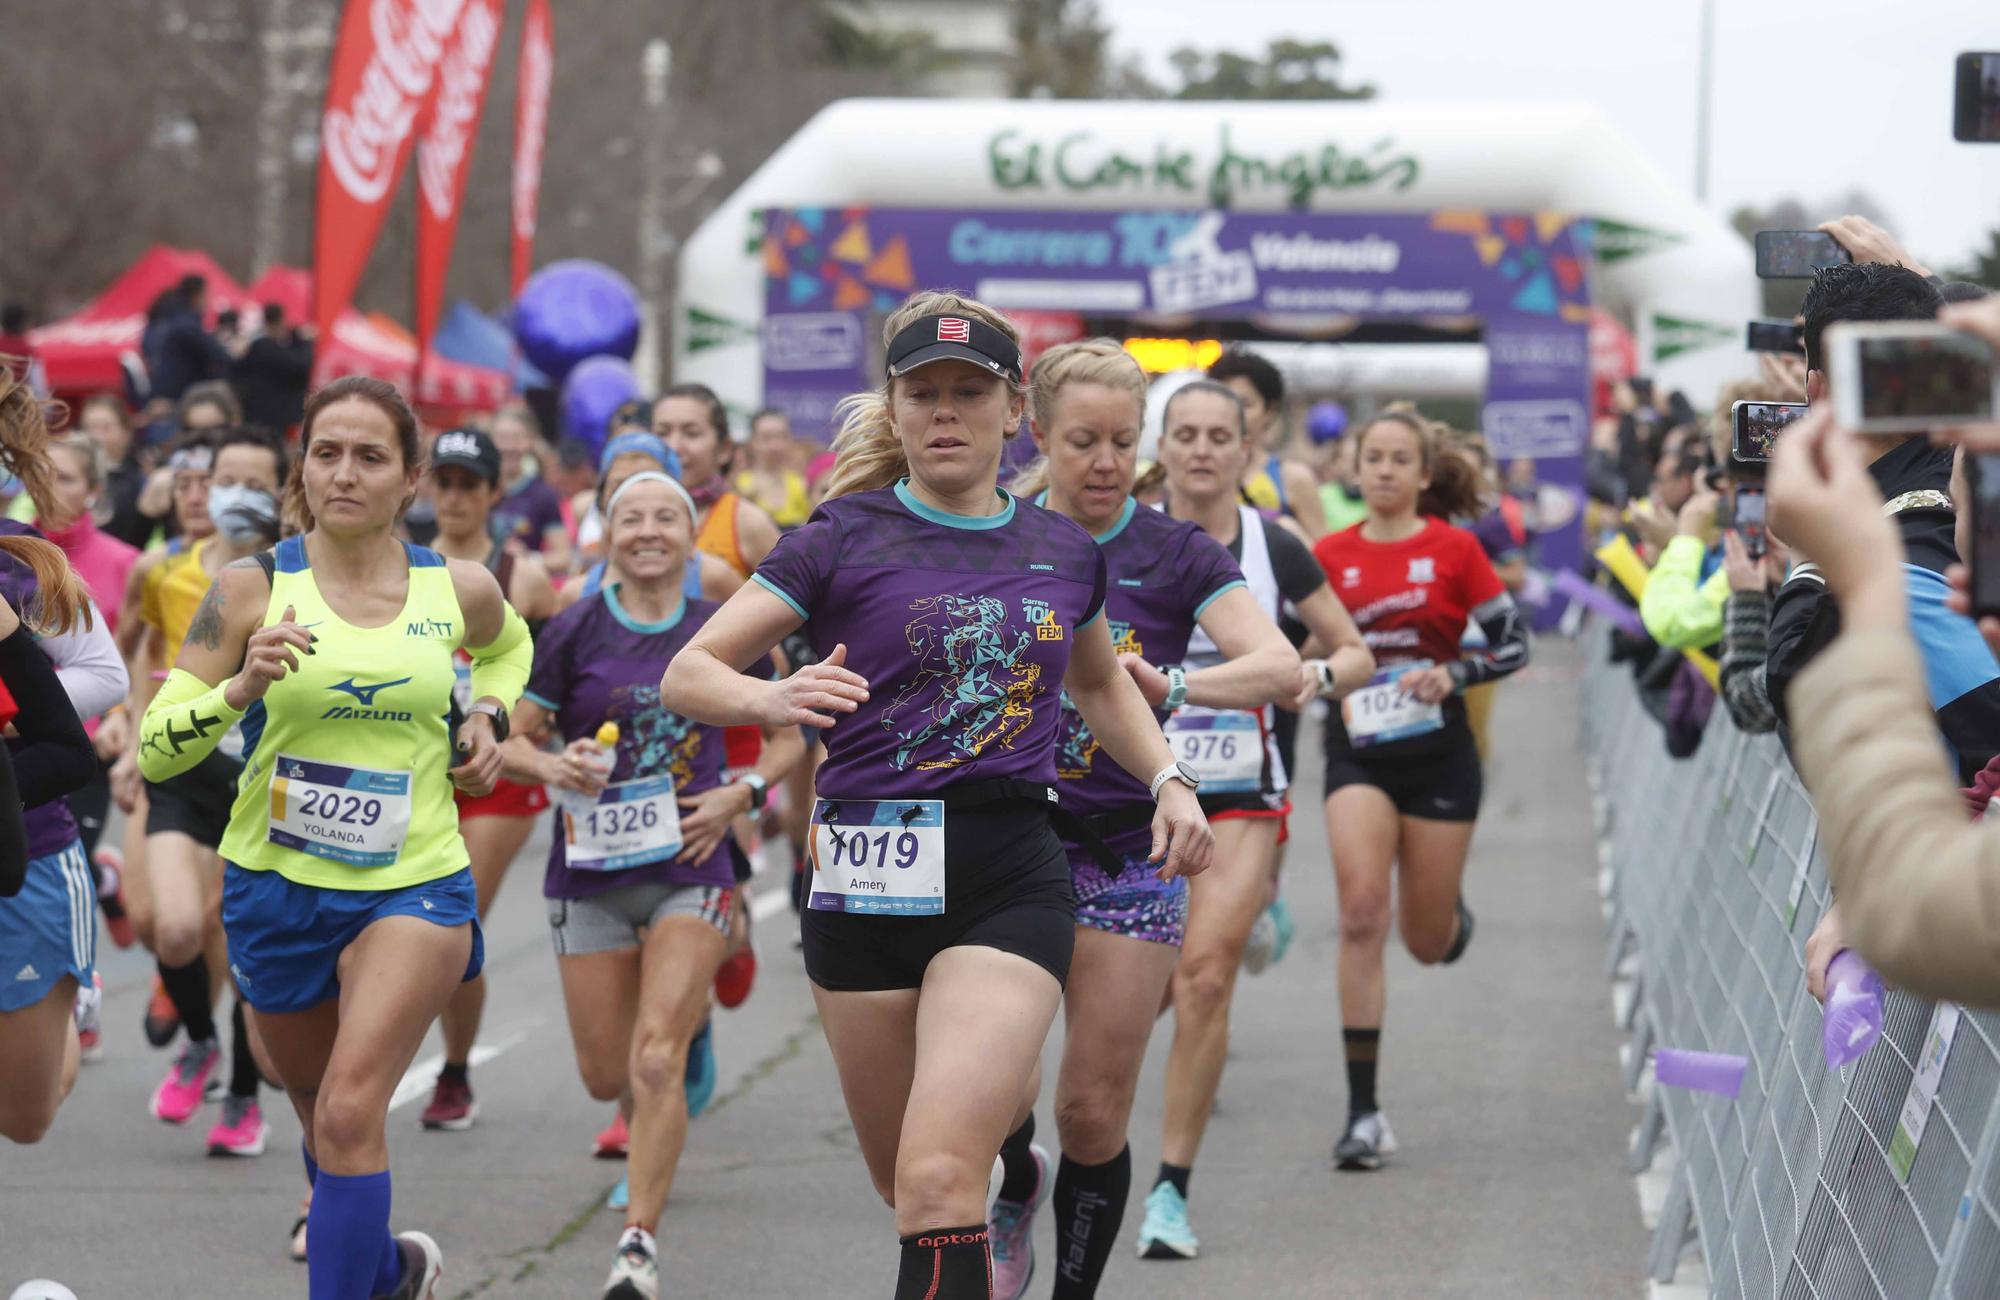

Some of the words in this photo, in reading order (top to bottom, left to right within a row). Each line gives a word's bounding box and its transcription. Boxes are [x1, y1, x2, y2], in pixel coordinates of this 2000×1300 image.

[988, 128, 1042, 189] El
[1055, 131, 1195, 190] Corte
[1209, 119, 1420, 208] Inglés
[948, 218, 1112, 269] Carrera
[1251, 232, 1400, 272] Valencia
[1022, 597, 1049, 608] Carrera
[1038, 625, 1062, 639] FEM
[1184, 735, 1237, 760] 976
[298, 789, 382, 827] 2029
[586, 802, 658, 837] 1326
[303, 823, 366, 845] YOLANDA
[830, 830, 919, 869] 1019
[850, 878, 887, 892] Amery
